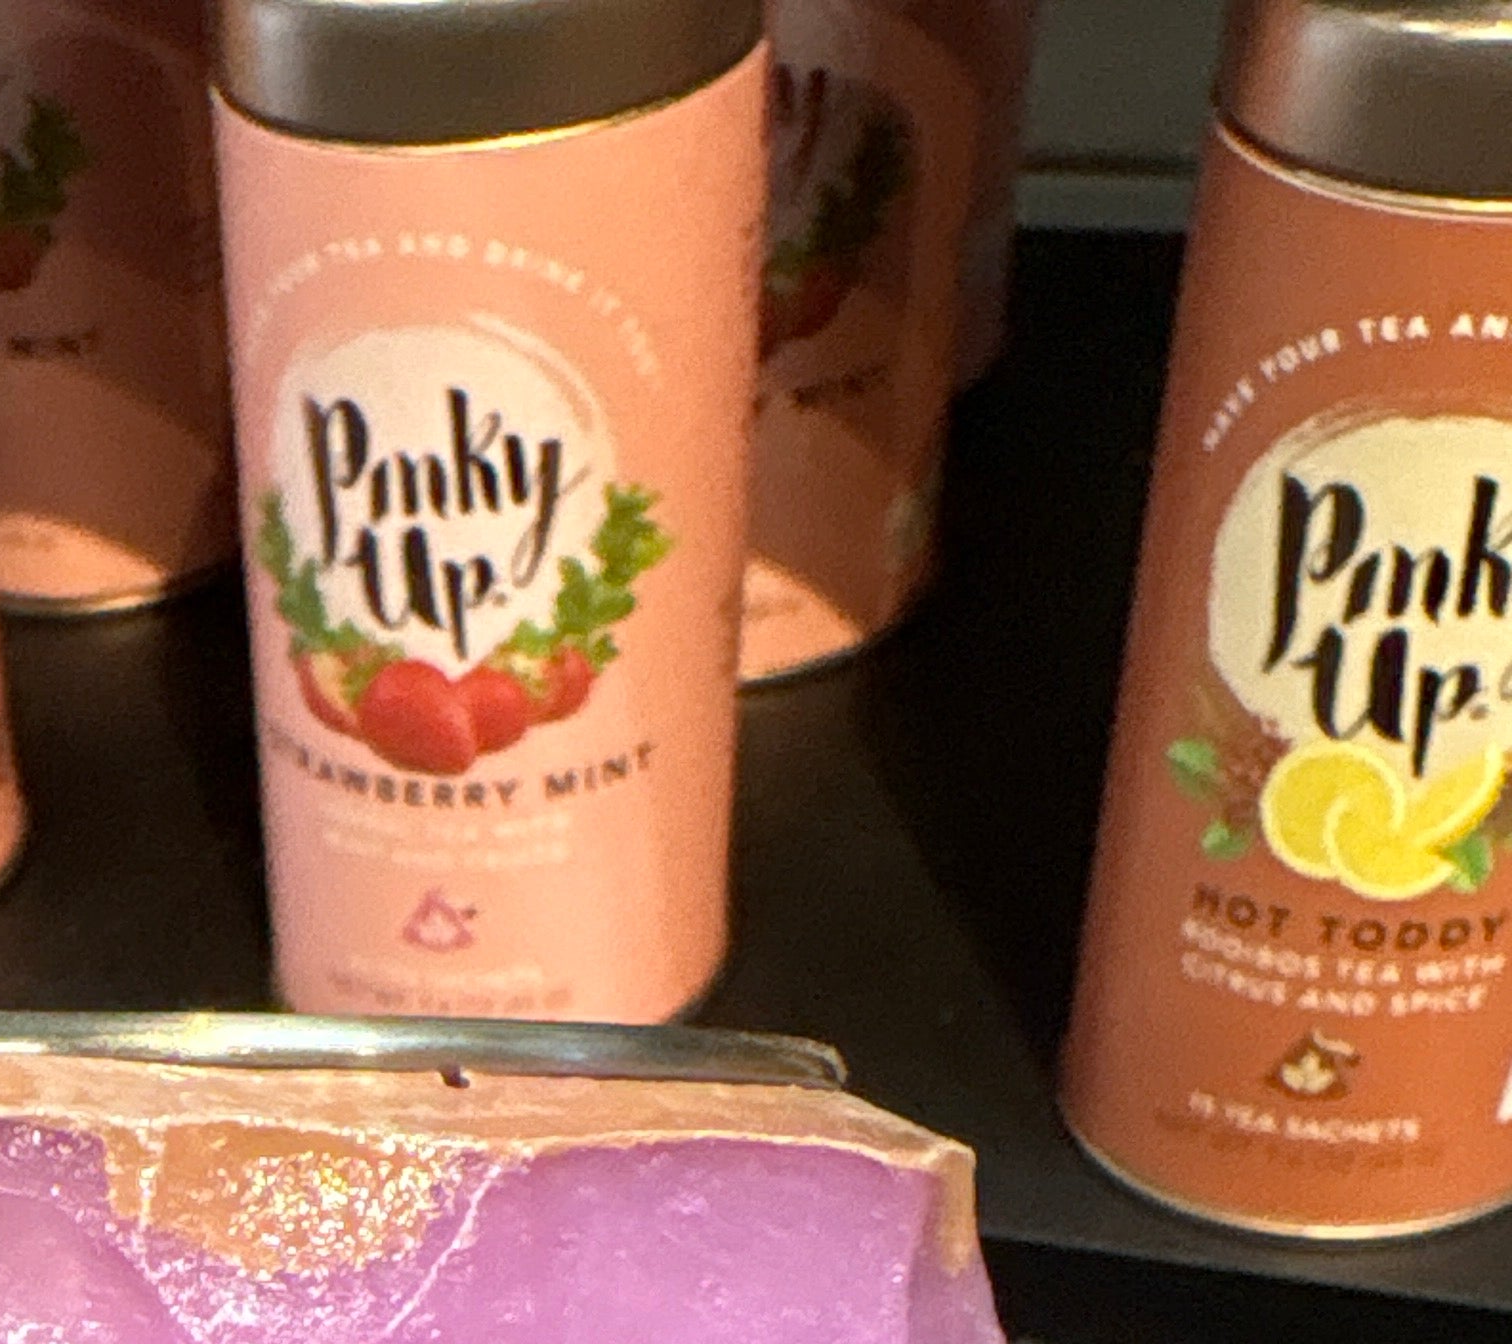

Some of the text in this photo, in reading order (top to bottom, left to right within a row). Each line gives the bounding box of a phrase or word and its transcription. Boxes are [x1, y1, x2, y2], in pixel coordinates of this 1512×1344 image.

[1357, 313, 1431, 346] TEA
[1448, 312, 1512, 340] AN
[300, 386, 592, 589] Pinky
[542, 736, 658, 798] MINT
[1192, 883, 1507, 951] HOT TODDY
[1336, 957, 1401, 985] TEA
